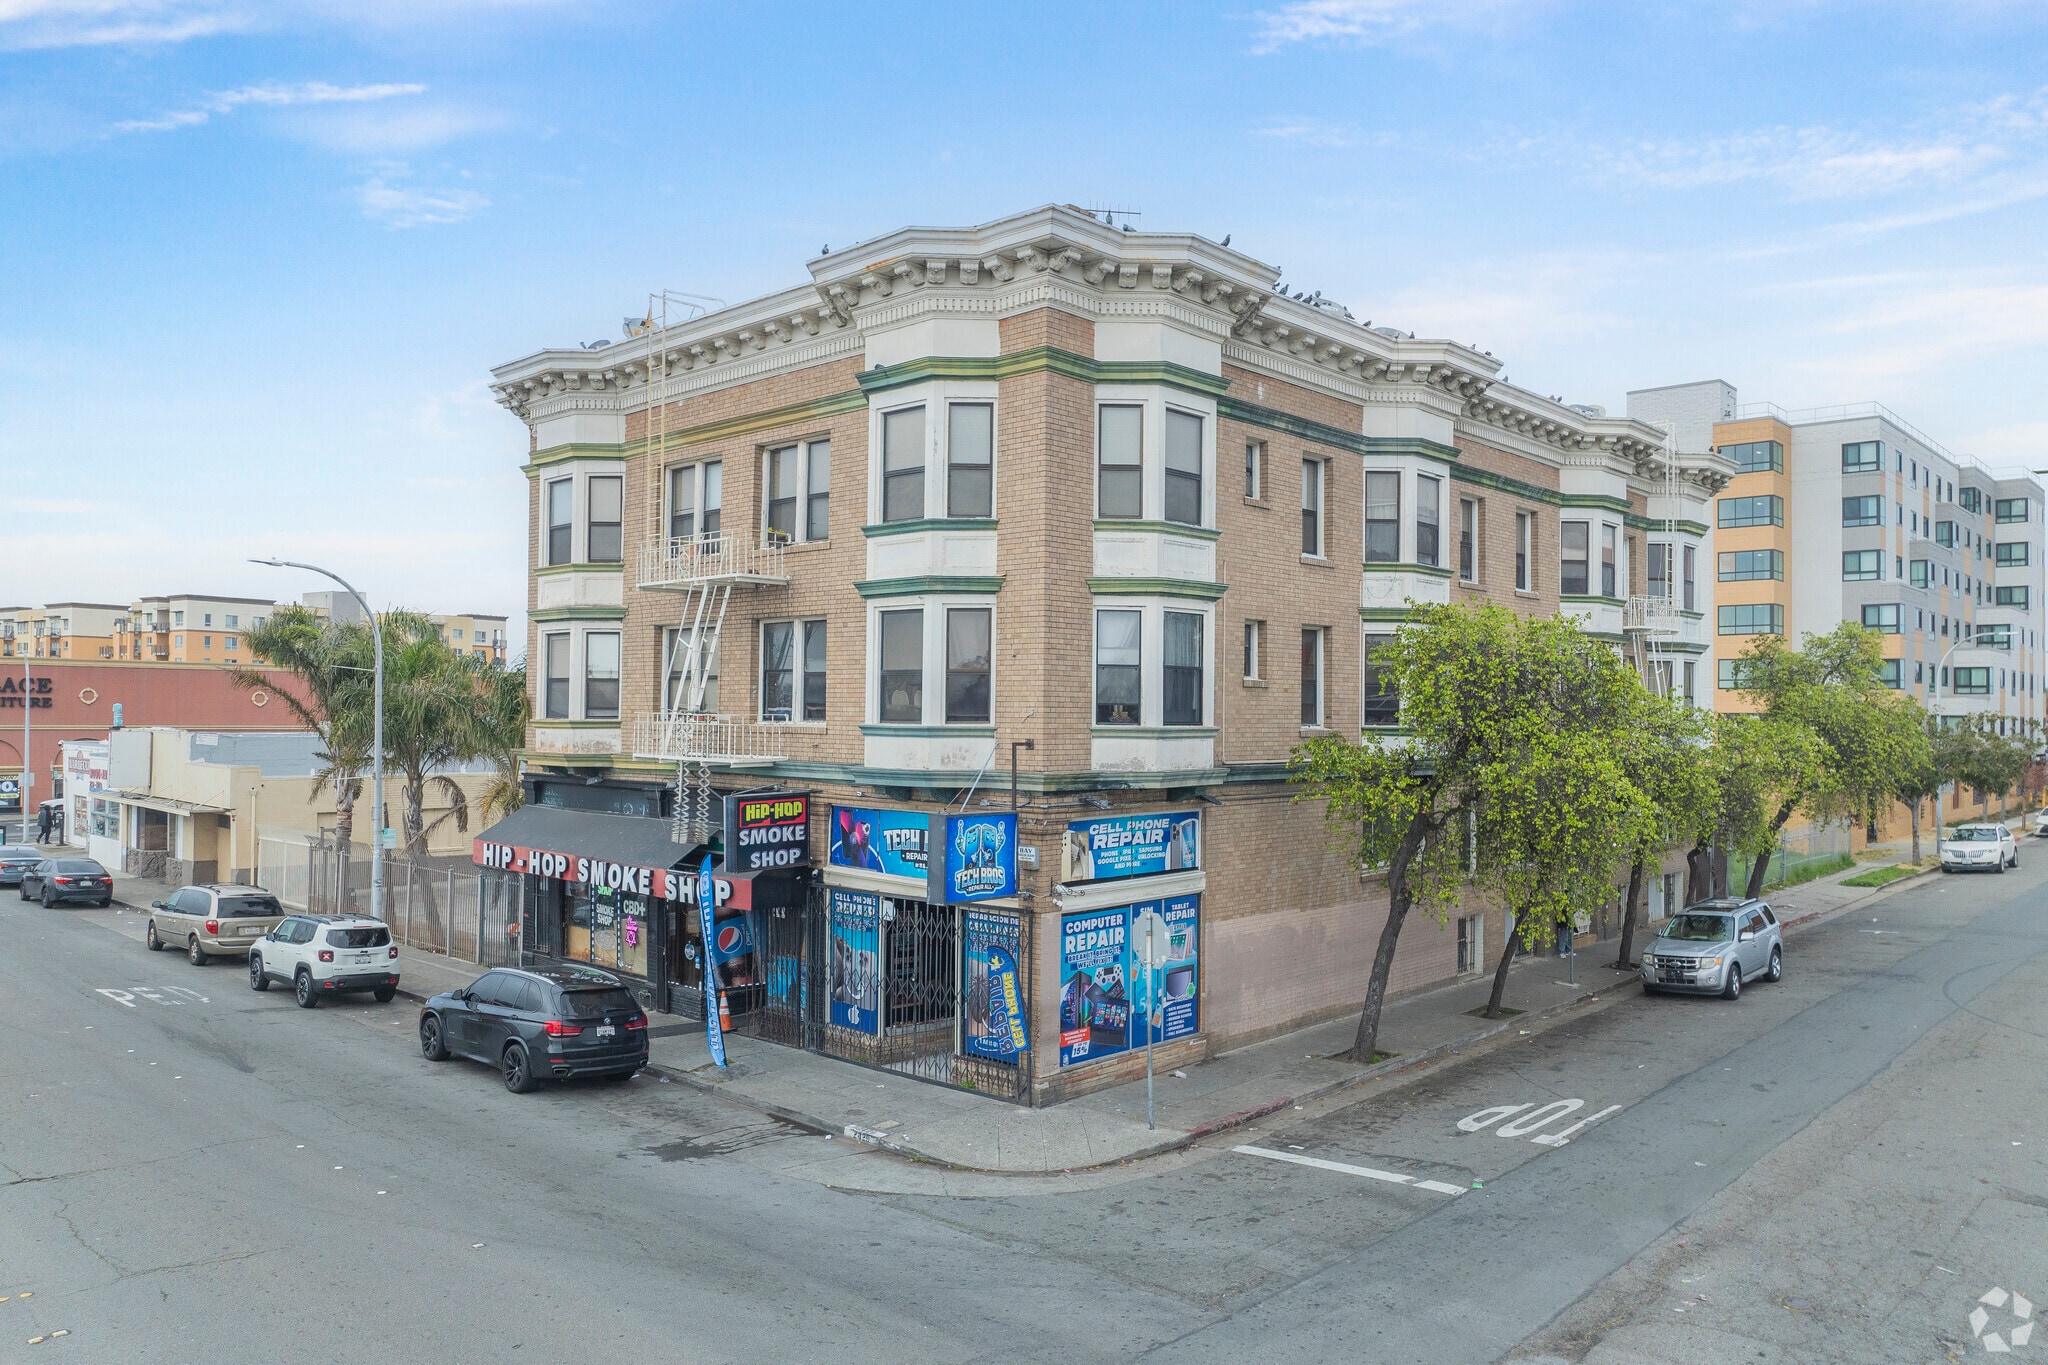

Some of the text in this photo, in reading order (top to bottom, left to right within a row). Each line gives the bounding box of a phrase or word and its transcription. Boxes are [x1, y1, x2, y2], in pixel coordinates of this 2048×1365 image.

[0, 677, 52, 693] ACE
[1089, 818, 1170, 835] CELL PHONE
[739, 825, 806, 846] SMOKE
[884, 829, 920, 851] TECH
[1092, 829, 1164, 850] REPAIR
[905, 852, 928, 861] REPAIR
[1138, 846, 1163, 854] SAMSUNG
[750, 848, 801, 869] SHOP
[1097, 857, 1119, 865] GOOGLE
[1137, 852, 1166, 860] UNLOCKING
[578, 858, 651, 896] SMOKE
[664, 874, 731, 907] SHP
[956, 867, 1004, 890] TECH BROS
[968, 884, 984, 893] REPAIR
[834, 892, 876, 905] CELL PHONE
[1171, 902, 1189, 910] TABLET
[596, 903, 615, 917] SMOKE
[623, 899, 646, 916] CBD+
[1165, 908, 1195, 922] REPAIR
[597, 913, 613, 926] SHOP
[1009, 916, 1019, 925] DE
[1066, 914, 1124, 934] COMPUTER
[1065, 927, 1125, 954] REPAIR
[95, 985, 211, 1008] PED
